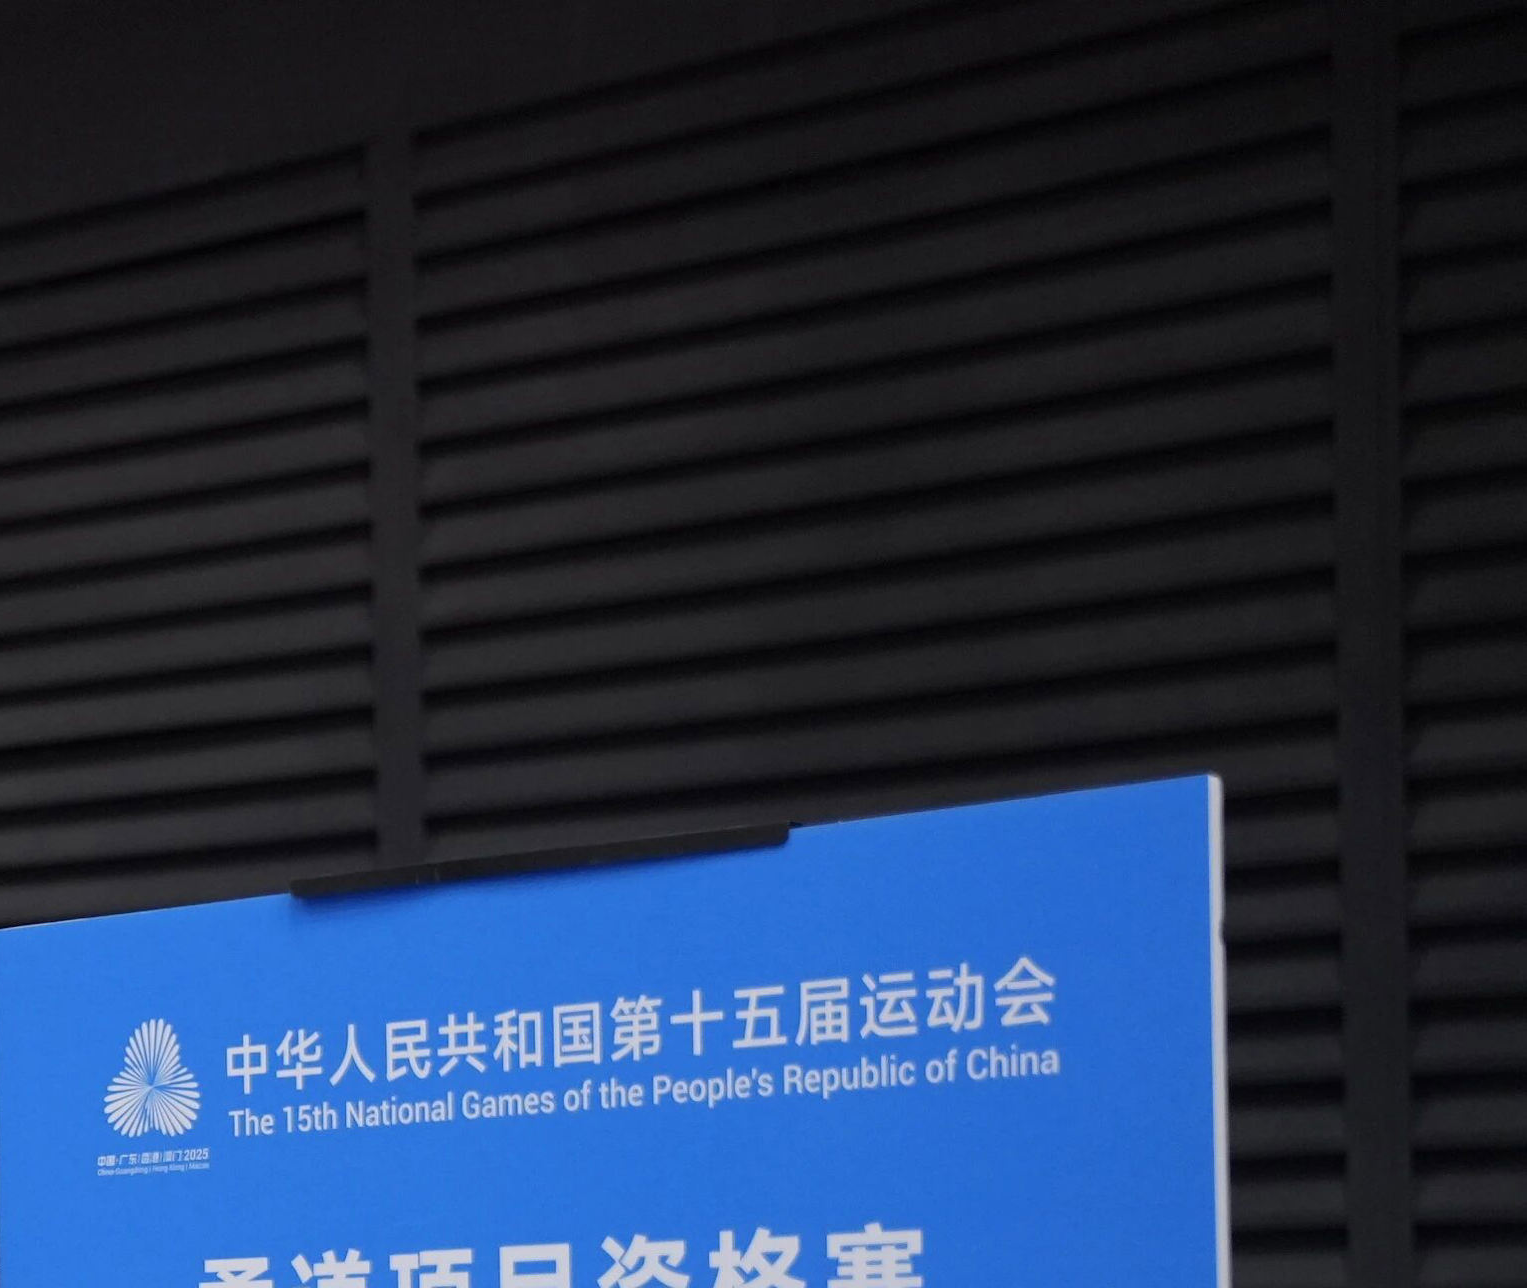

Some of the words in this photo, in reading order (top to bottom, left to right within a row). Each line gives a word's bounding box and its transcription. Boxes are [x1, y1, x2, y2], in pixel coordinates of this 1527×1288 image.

[227, 957, 1055, 1094] 中华人民共和国第十五届运动会
[228, 1108, 275, 1137] The
[283, 1101, 338, 1132] 15th
[345, 1091, 454, 1128] National
[462, 1091, 555, 1119] Games
[564, 1080, 592, 1111] of
[599, 1077, 644, 1108] the
[653, 1067, 774, 1108] People's
[784, 1055, 915, 1099] Republic
[926, 1050, 957, 1083] of
[967, 1045, 1059, 1080] China
[184, 1147, 209, 1162] 2025
